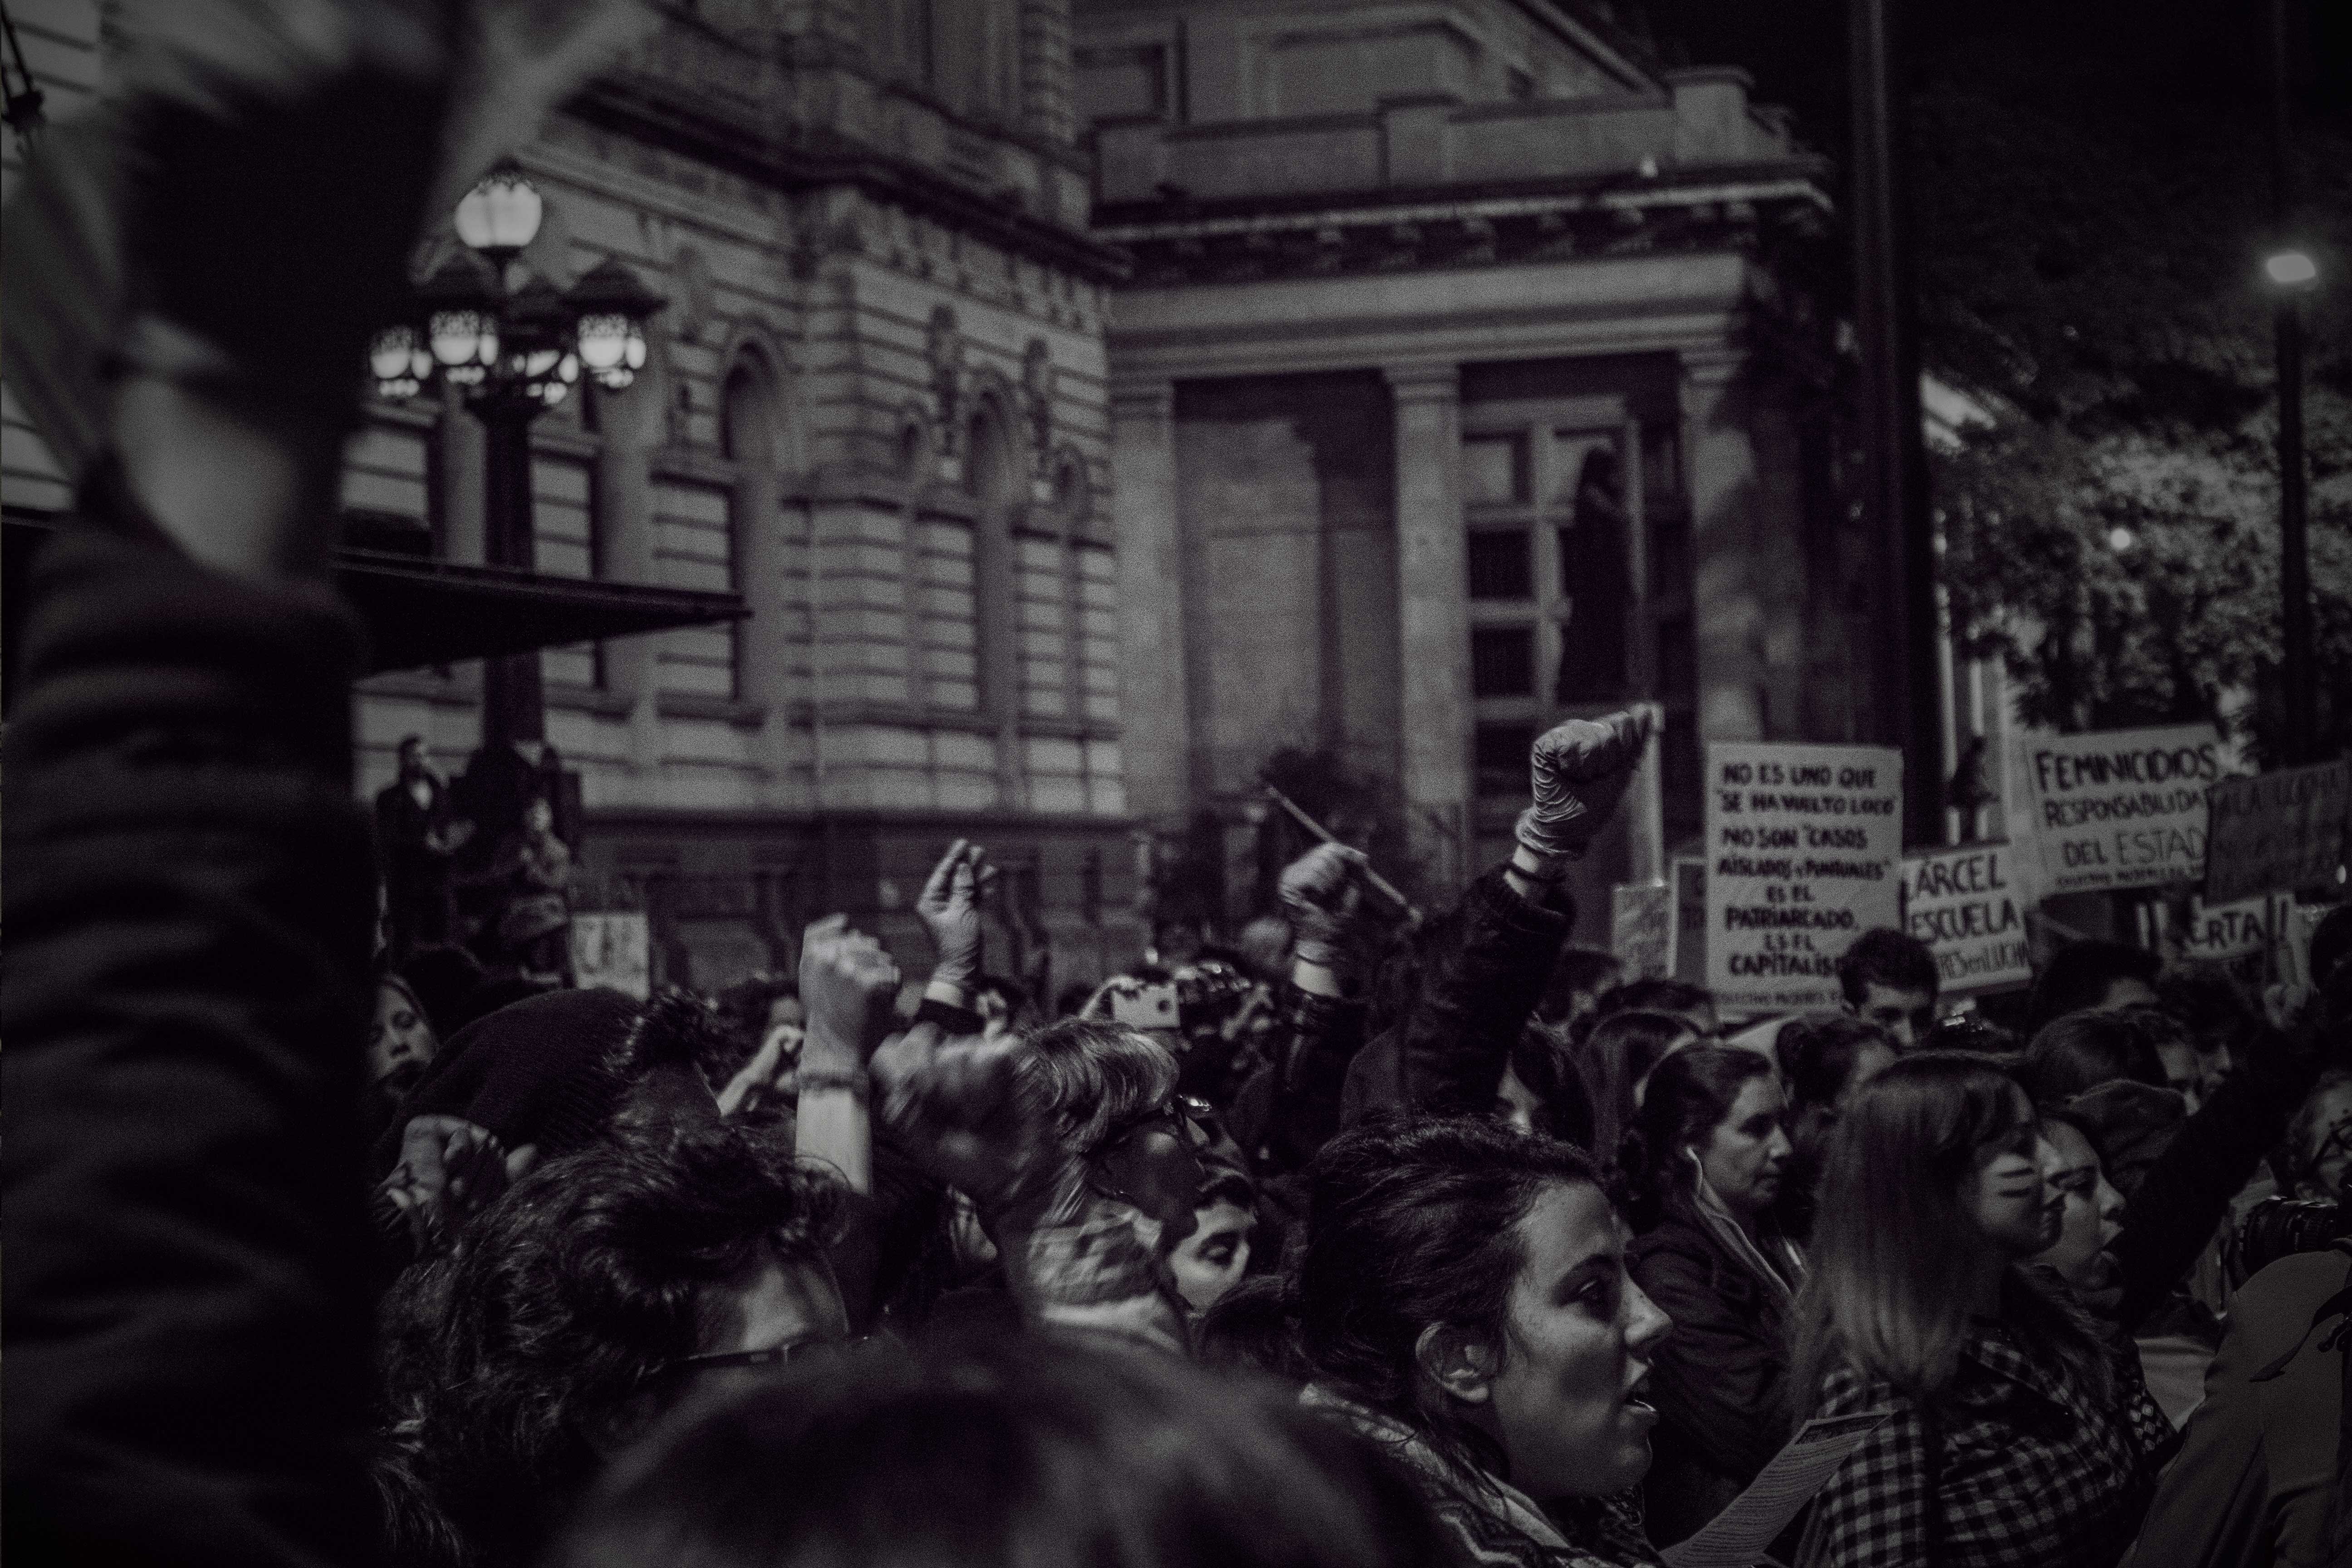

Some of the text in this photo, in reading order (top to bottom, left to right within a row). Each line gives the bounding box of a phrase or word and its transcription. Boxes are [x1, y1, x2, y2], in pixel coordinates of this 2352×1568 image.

[1723, 763, 1875, 788] NO ES UNO QUE
[2036, 743, 2218, 792] FEMINICIDIOS
[1750, 794, 1779, 811] HA
[1780, 795, 1846, 815] VUELTO
[1723, 828, 1754, 847] NO
[1757, 828, 1798, 848] SON
[2063, 840, 2109, 868] DEL
[1908, 852, 2006, 899] ÁRCEL
[1766, 885, 1814, 904] ES EL
[1910, 897, 2019, 946] ESCUELA
[1765, 933, 1815, 952] ES EL
